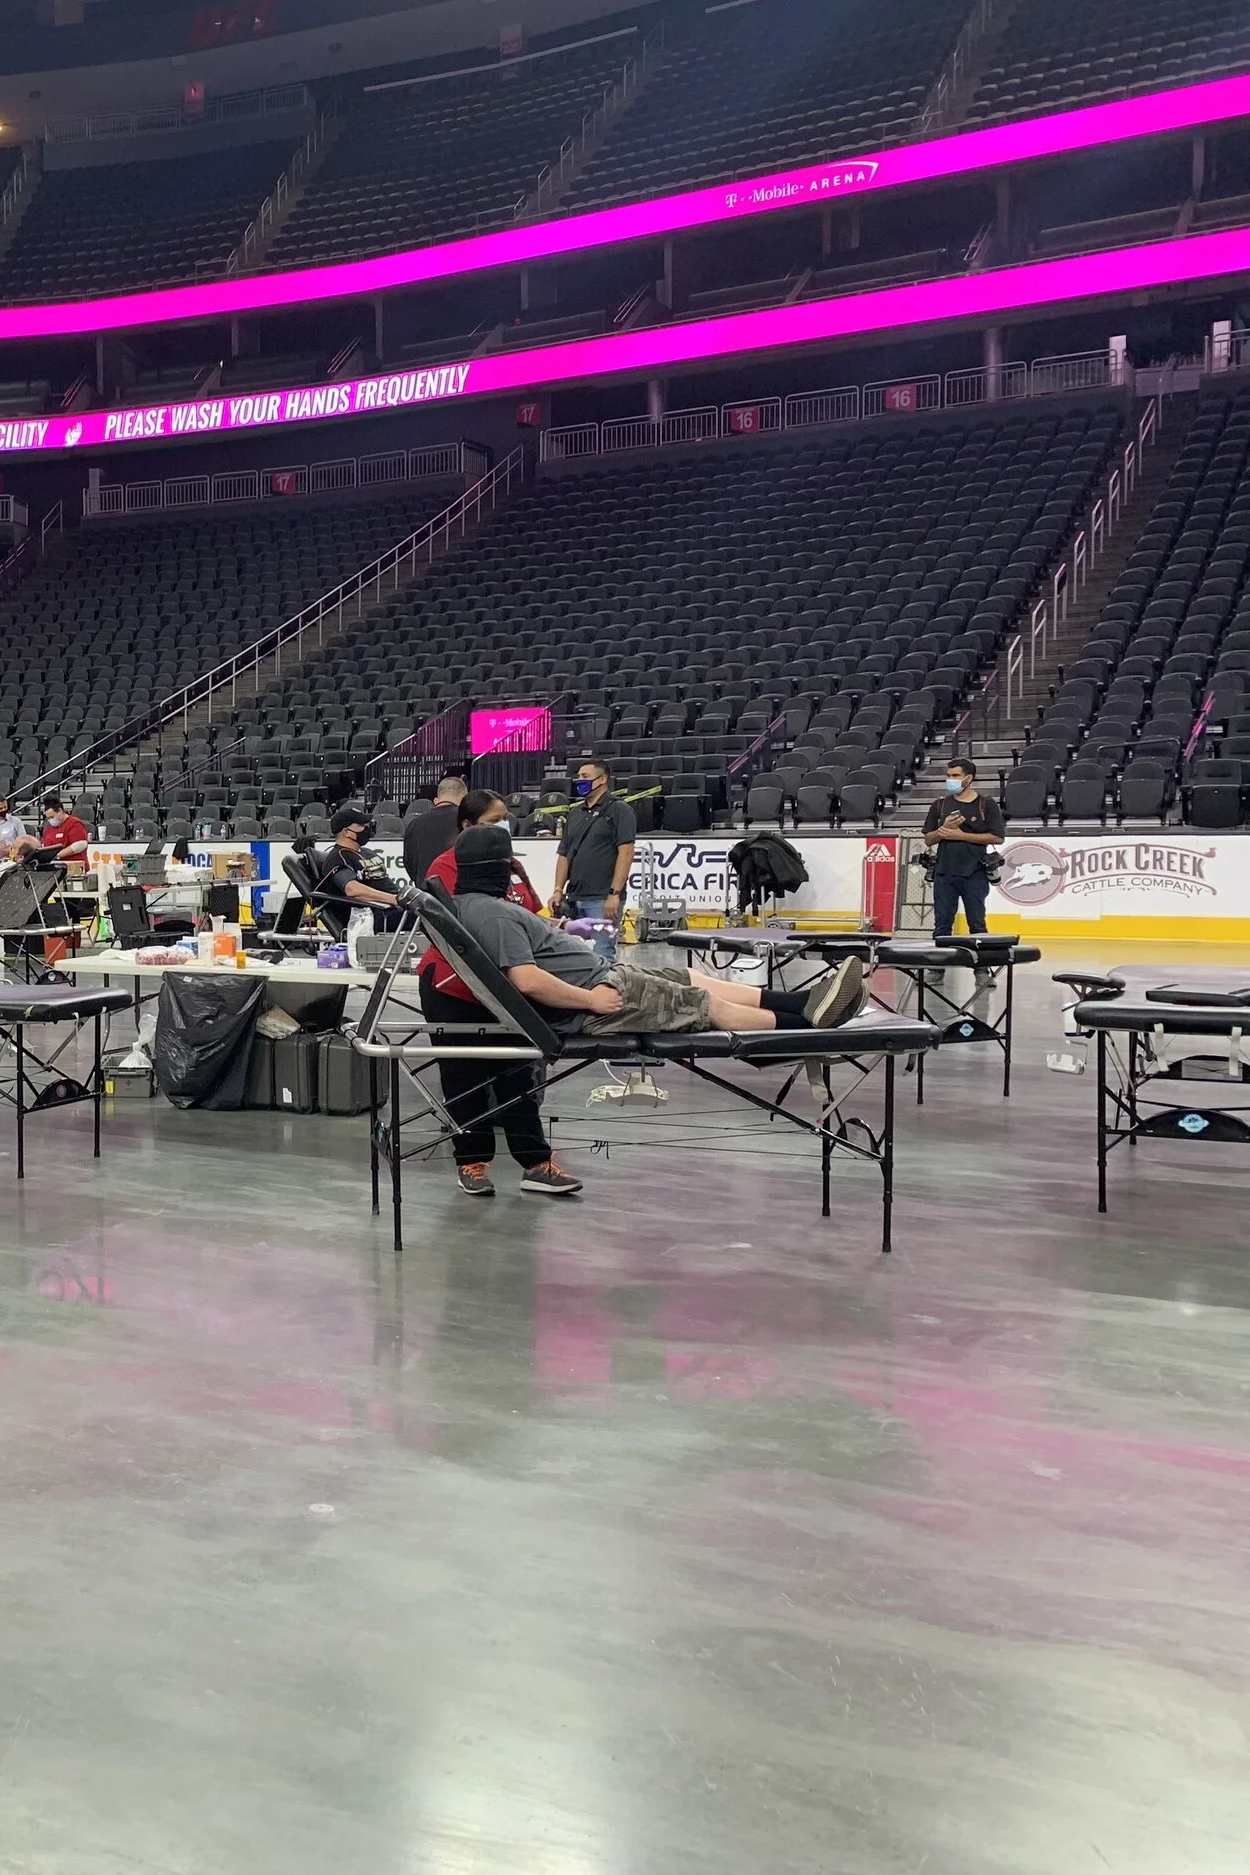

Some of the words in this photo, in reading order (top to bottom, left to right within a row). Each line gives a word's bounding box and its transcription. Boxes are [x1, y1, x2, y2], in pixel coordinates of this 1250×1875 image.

[810, 171, 865, 191] ARENA
[104, 408, 168, 440] PLEASE
[171, 401, 224, 431] WASH
[229, 395, 282, 426] YOUR
[285, 386, 352, 419] HANDS
[354, 364, 471, 410] FREQUENTLY
[892, 390, 911, 408] 16
[521, 406, 535, 423] 17
[736, 412, 753, 429] 16
[277, 476, 291, 491] 17
[1070, 850, 1127, 878] ROCK
[1134, 843, 1204, 879] CREEK
[1071, 878, 1125, 894] CATTLE
[1131, 877, 1203, 895] COMPANY
